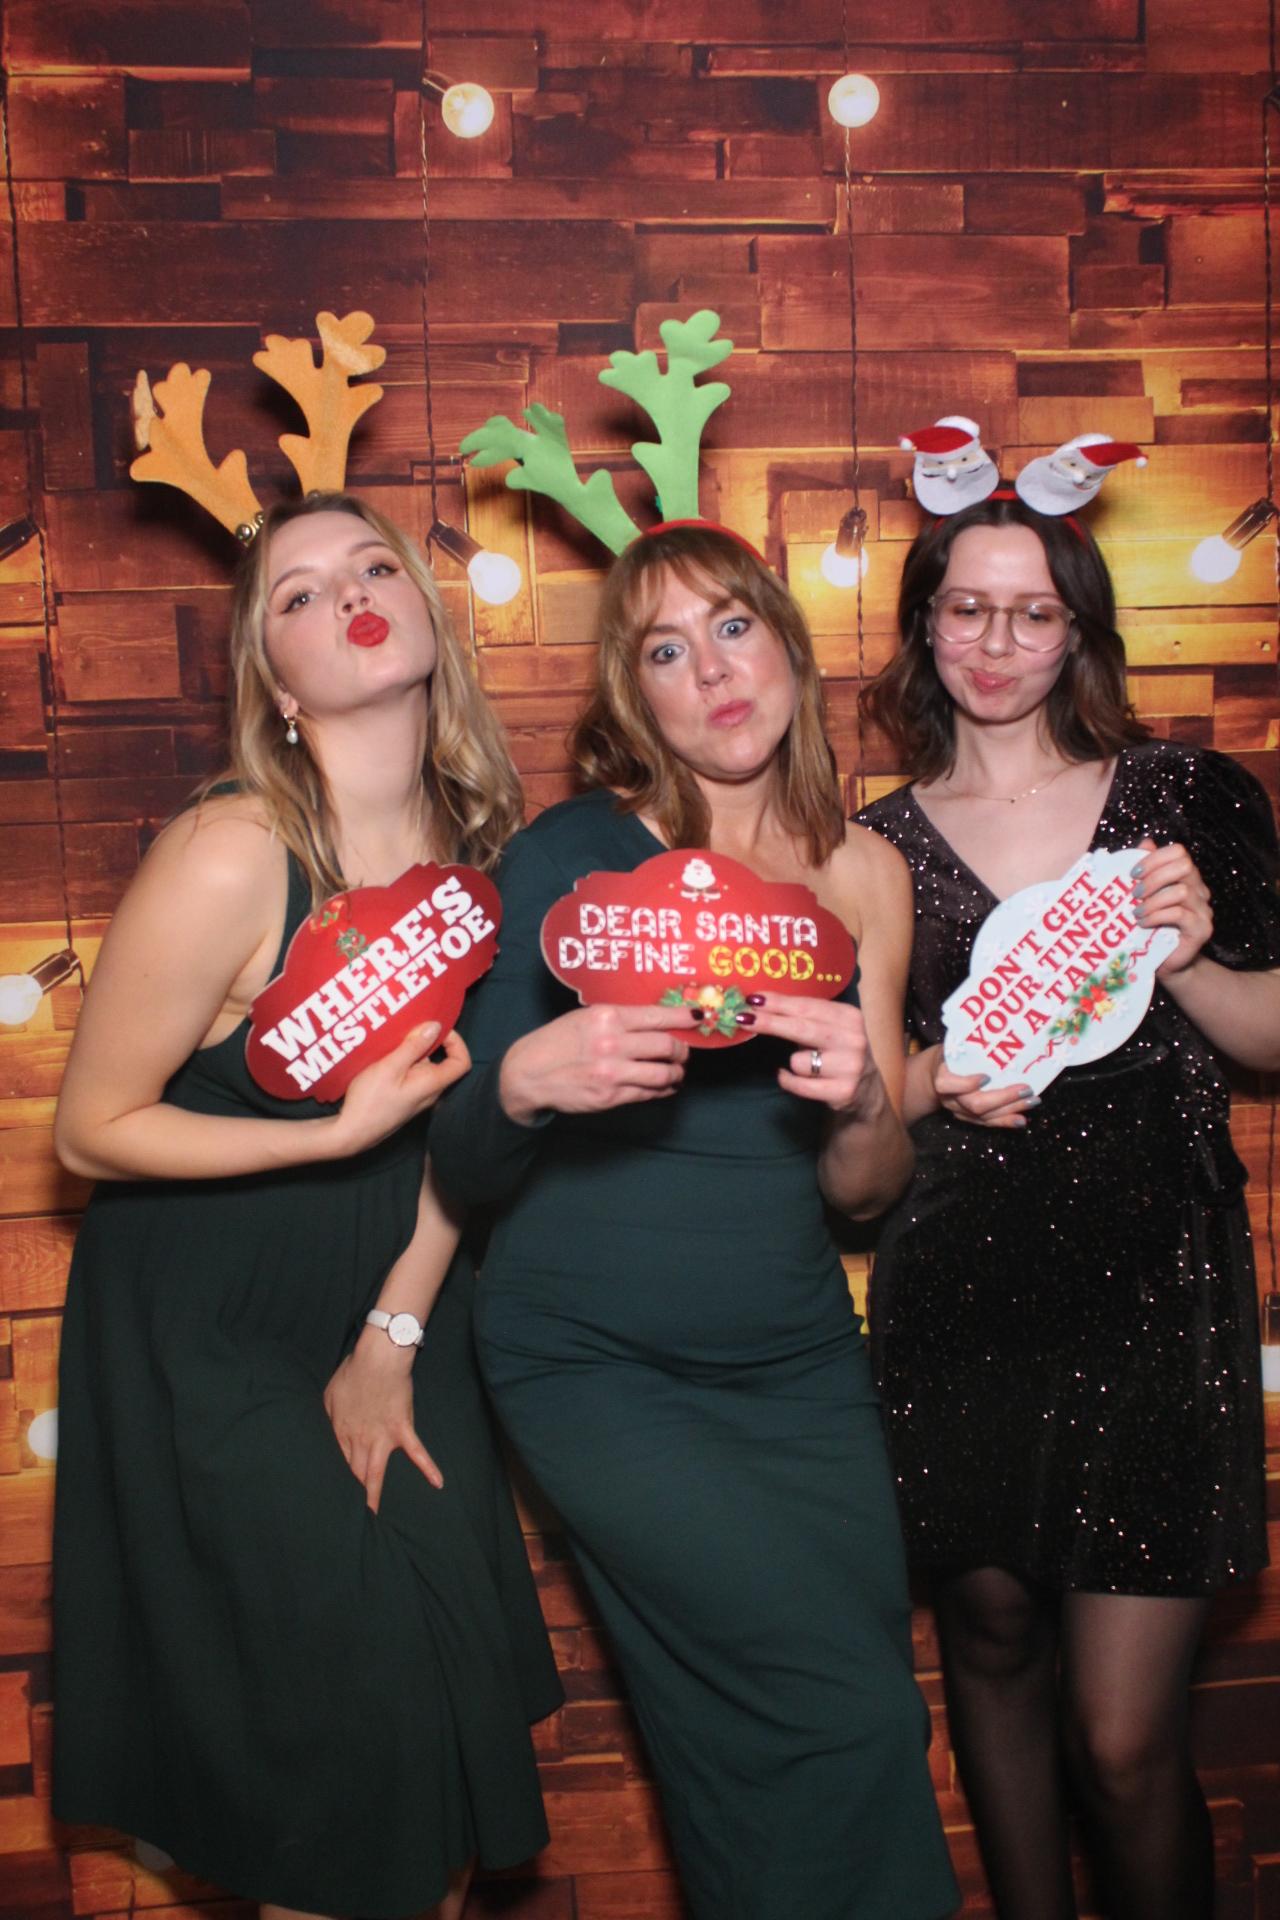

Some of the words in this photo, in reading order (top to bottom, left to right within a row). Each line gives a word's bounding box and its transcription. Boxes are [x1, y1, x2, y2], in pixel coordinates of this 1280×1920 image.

[260, 876, 472, 1061] WHERE'S
[286, 905, 495, 1092] MISTLETOE
[558, 936, 697, 975] DEFINE
[708, 945, 842, 982] GOOD...
[579, 903, 682, 940] DEAR
[695, 911, 819, 948] SANTA
[959, 930, 1044, 1022] DON'T
[1042, 871, 1098, 933] GET
[965, 974, 1044, 1050] YOUR
[1038, 875, 1137, 974] TINSEL
[987, 1030, 1025, 1070] IN
[1023, 1007, 1051, 1034] A
[1045, 897, 1142, 1006] TANGL
